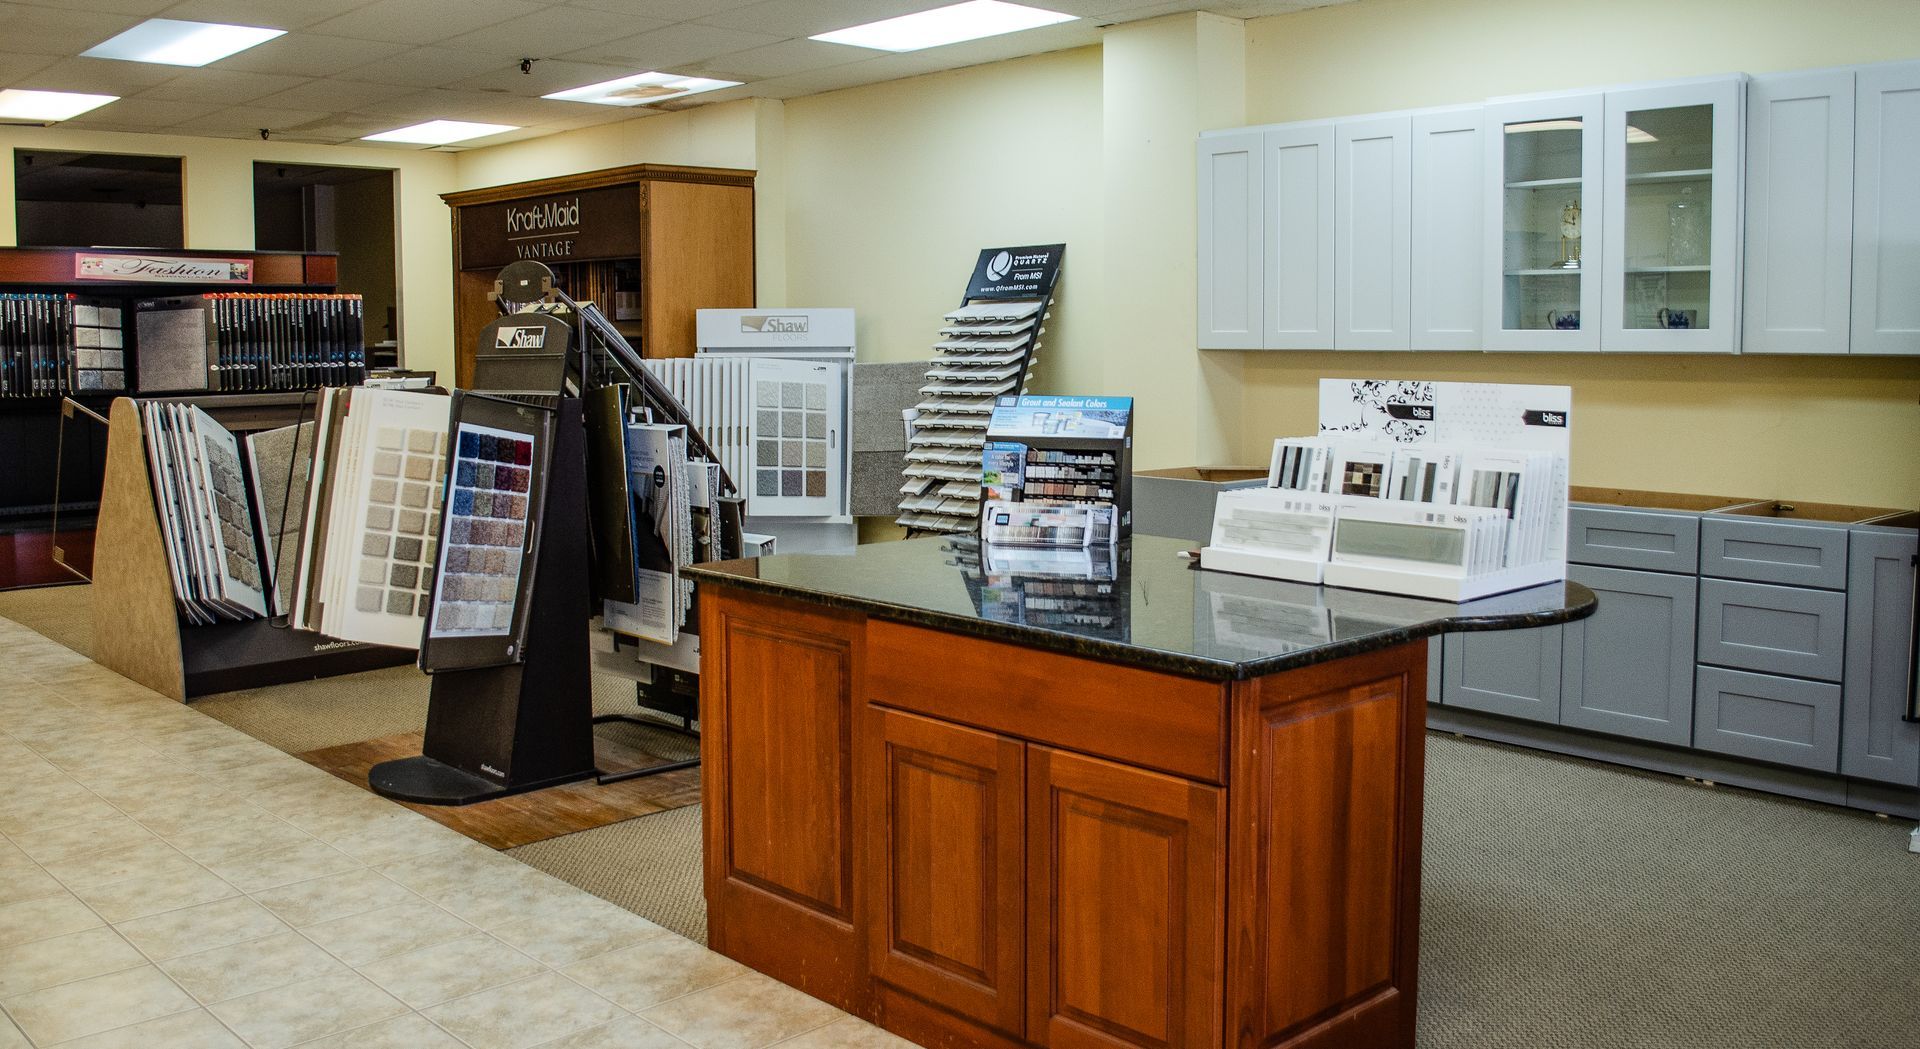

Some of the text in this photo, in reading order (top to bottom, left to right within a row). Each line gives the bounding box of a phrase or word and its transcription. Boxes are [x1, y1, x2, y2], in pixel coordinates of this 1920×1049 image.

[507, 198, 580, 232] KraftMaid
[517, 240, 572, 259] VANTAGE
[114, 258, 222, 276] Fashion
[1013, 258, 1048, 266] QUARTZ
[1014, 272, 1043, 280] From MSI
[767, 318, 807, 332] Shaw
[511, 329, 543, 348] Shaw
[1021, 398, 1042, 407] Grout
[1043, 399, 1056, 407] and
[1086, 399, 1107, 408] Colors
[1412, 406, 1431, 417] bliss
[1542, 412, 1563, 423] bliss
[314, 641, 365, 652] shawfloors.co
